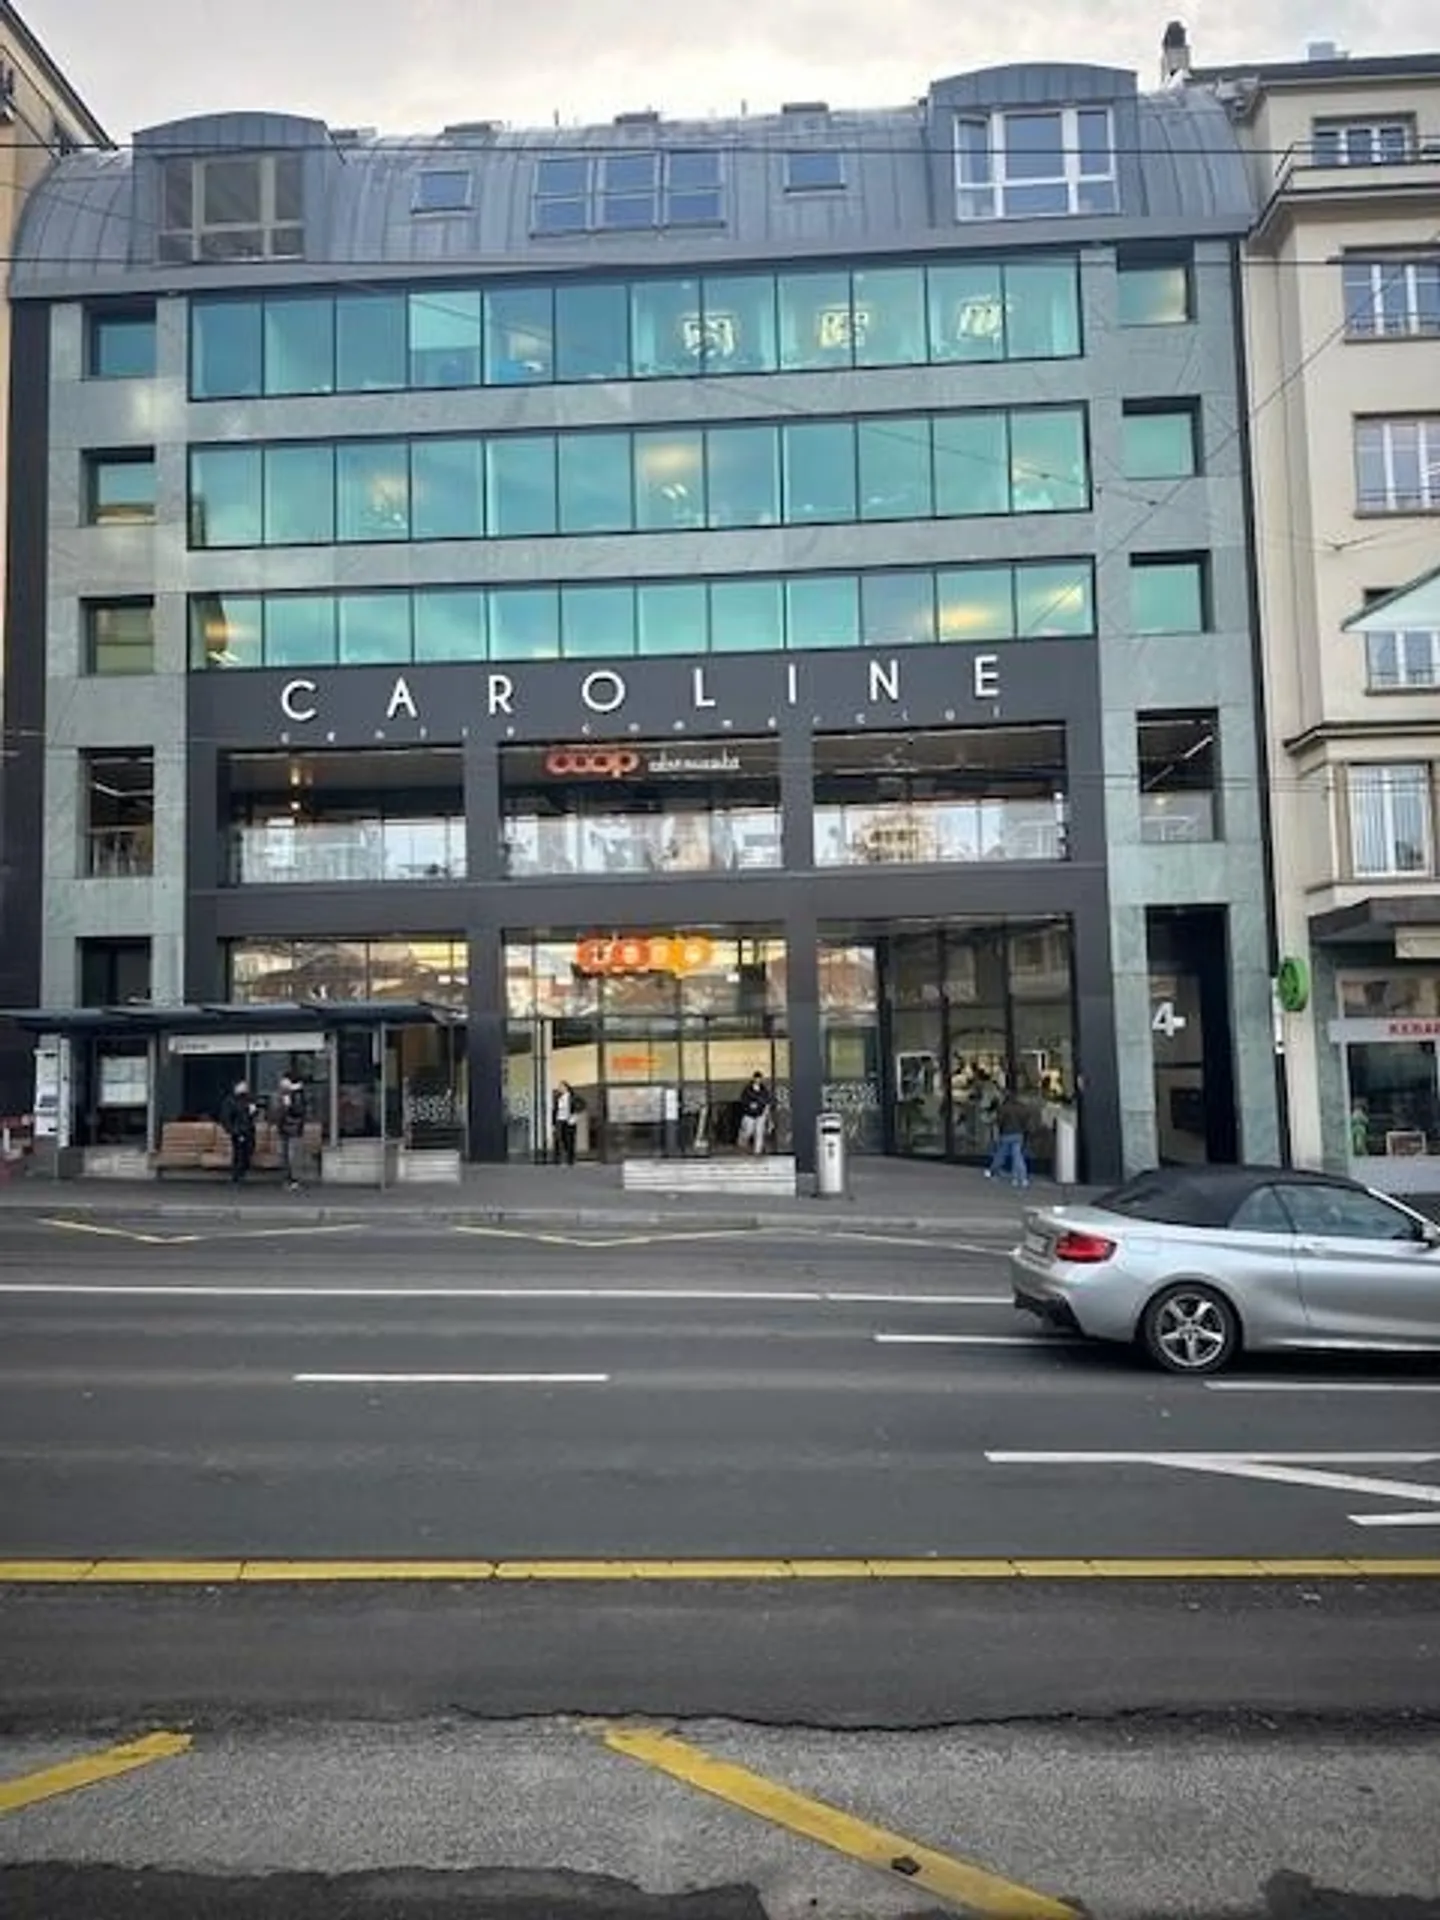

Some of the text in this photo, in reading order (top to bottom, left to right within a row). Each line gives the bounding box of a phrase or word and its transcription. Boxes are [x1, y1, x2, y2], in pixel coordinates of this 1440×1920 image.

[280, 654, 1001, 722] CAROLINE
[546, 750, 639, 778] coop
[1151, 1001, 1186, 1037] 4
